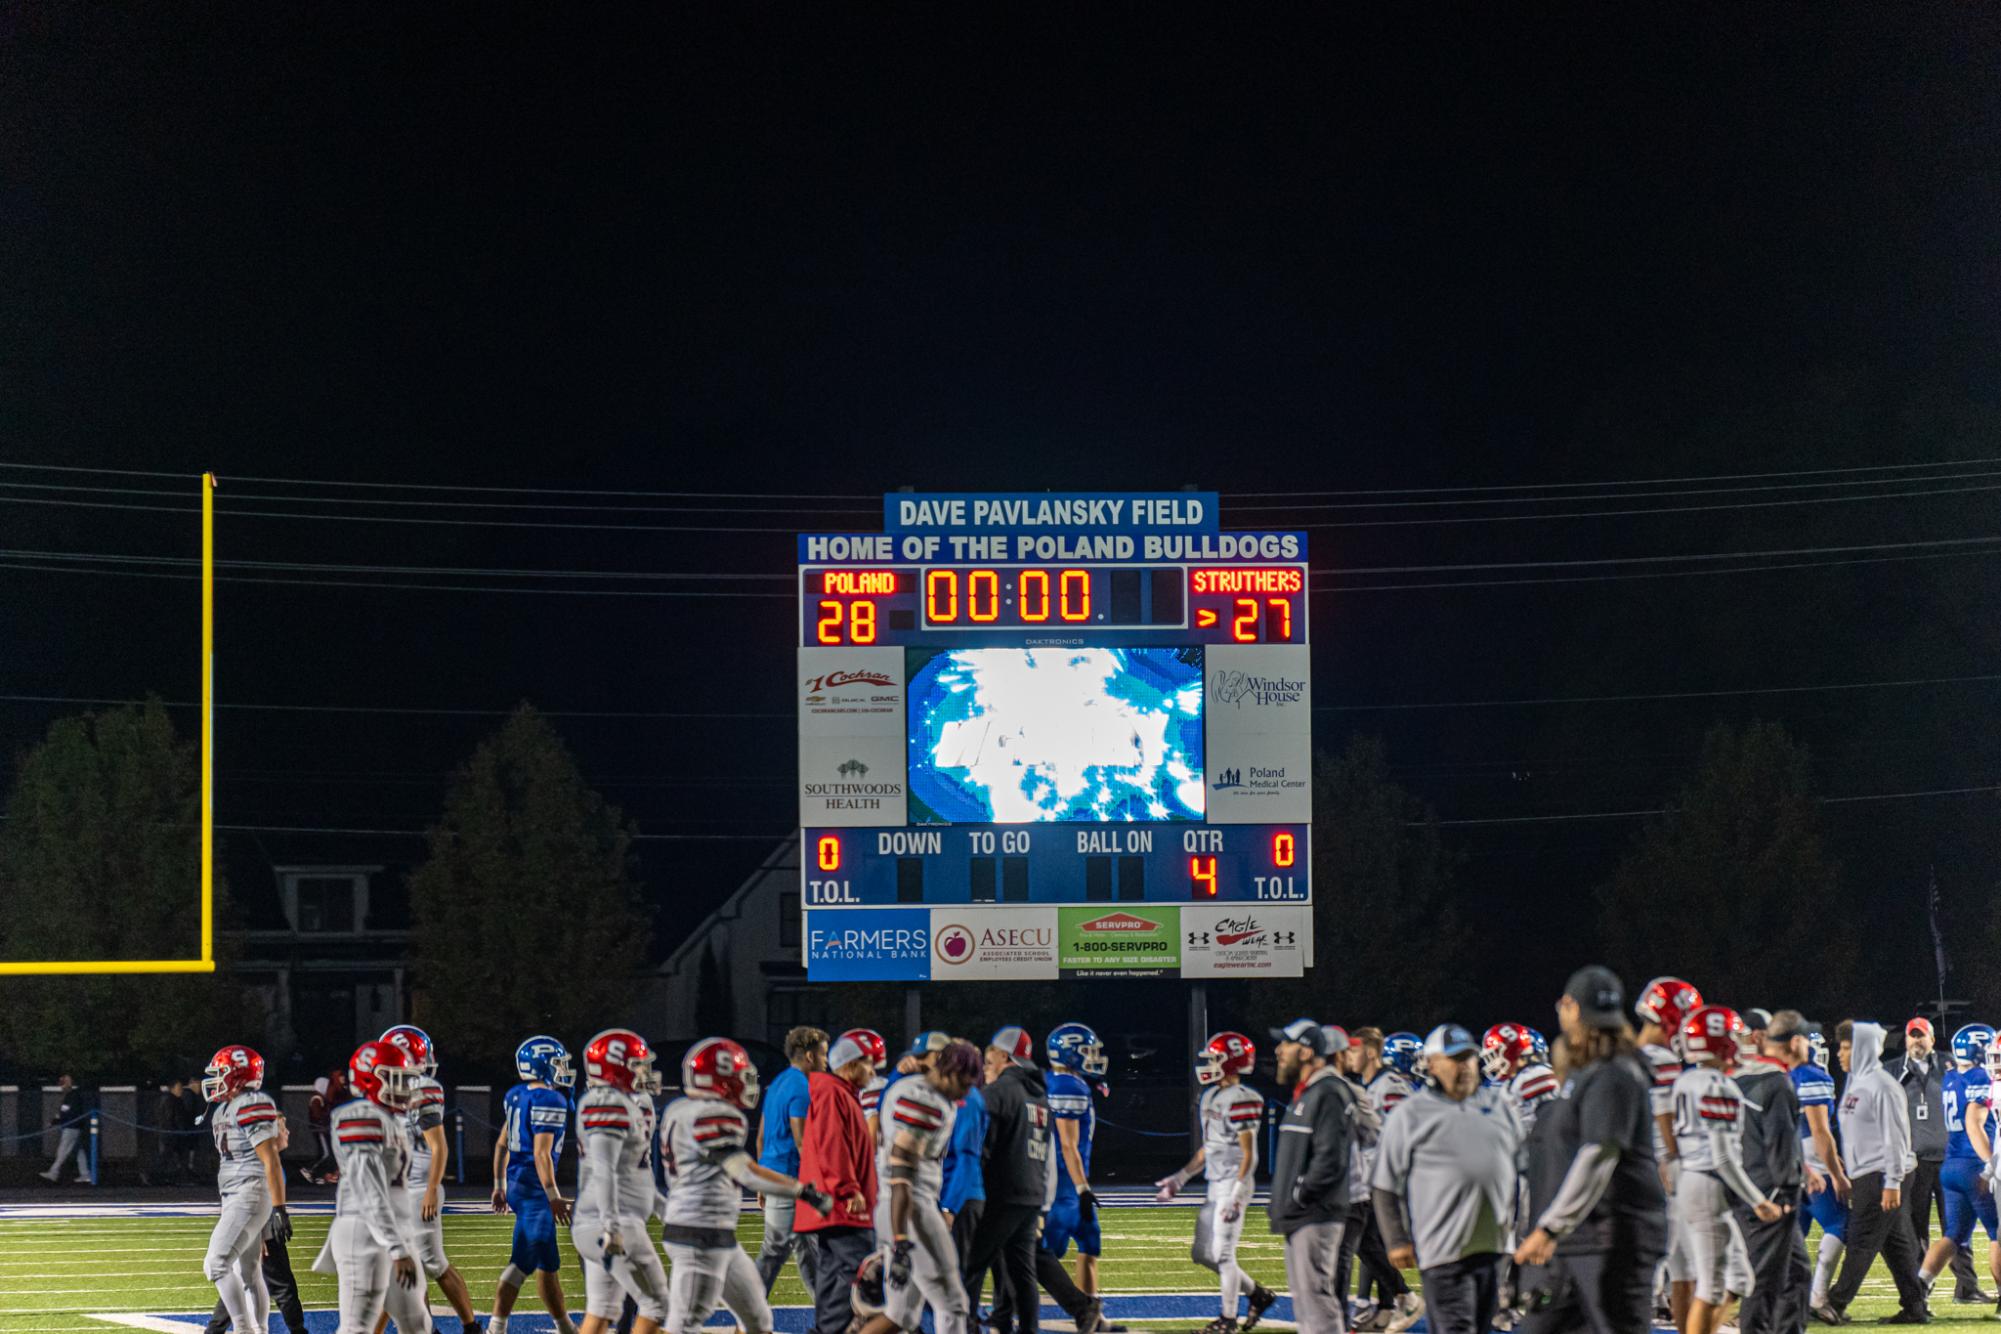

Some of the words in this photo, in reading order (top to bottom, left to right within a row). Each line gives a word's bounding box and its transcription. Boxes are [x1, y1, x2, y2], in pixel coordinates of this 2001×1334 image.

[900, 500, 966, 526] DAVE
[974, 500, 1125, 526] PAVLANSKY
[1132, 500, 1203, 525] FIELD
[808, 537, 893, 560] HOME
[902, 536, 940, 560] OF
[949, 536, 1008, 560] THE
[1017, 536, 1135, 560] POLAND
[1144, 535, 1298, 559] BULLDOGS
[824, 572, 895, 594] POLAND
[1193, 571, 1301, 592] STRUTHERS
[818, 601, 875, 643] 28
[1234, 598, 1290, 641] 27
[825, 669, 894, 688] Cochran
[1248, 677, 1306, 691] Windsor
[1256, 692, 1300, 705] House
[1250, 767, 1285, 778] Poland
[1250, 779, 1279, 788] Medical
[1281, 779, 1306, 788] Center
[804, 783, 901, 795] SOUTHWOODS
[826, 798, 880, 809] HEALTH
[879, 832, 941, 855] DOWN
[969, 831, 995, 854] TO
[1002, 831, 1030, 854] GO
[1077, 831, 1122, 853] BALL
[1127, 831, 1152, 853] ON
[1183, 830, 1223, 853] QTR
[1275, 834, 1293, 867] 0
[819, 837, 839, 870] 0
[1191, 857, 1216, 895] 4
[809, 881, 860, 903] T.O.L.
[1254, 877, 1304, 899] T.O.L.
[811, 930, 926, 950] FARMERS
[980, 928, 1051, 946] ASECU
[1073, 942, 1168, 952] 1-800-SERVPRO
[812, 951, 882, 960] NATIONAL
[891, 951, 926, 960] BANK
[1706, 1012, 1725, 1037] S
[1061, 1033, 1083, 1049] P
[1227, 1038, 1244, 1057] S
[1967, 1031, 1990, 1046] P
[230, 1049, 248, 1067] S
[355, 1048, 376, 1072] S
[531, 1044, 555, 1058] P
[605, 1040, 627, 1066] S
[715, 1050, 733, 1076] S
[1942, 1090, 1964, 1132] 12
